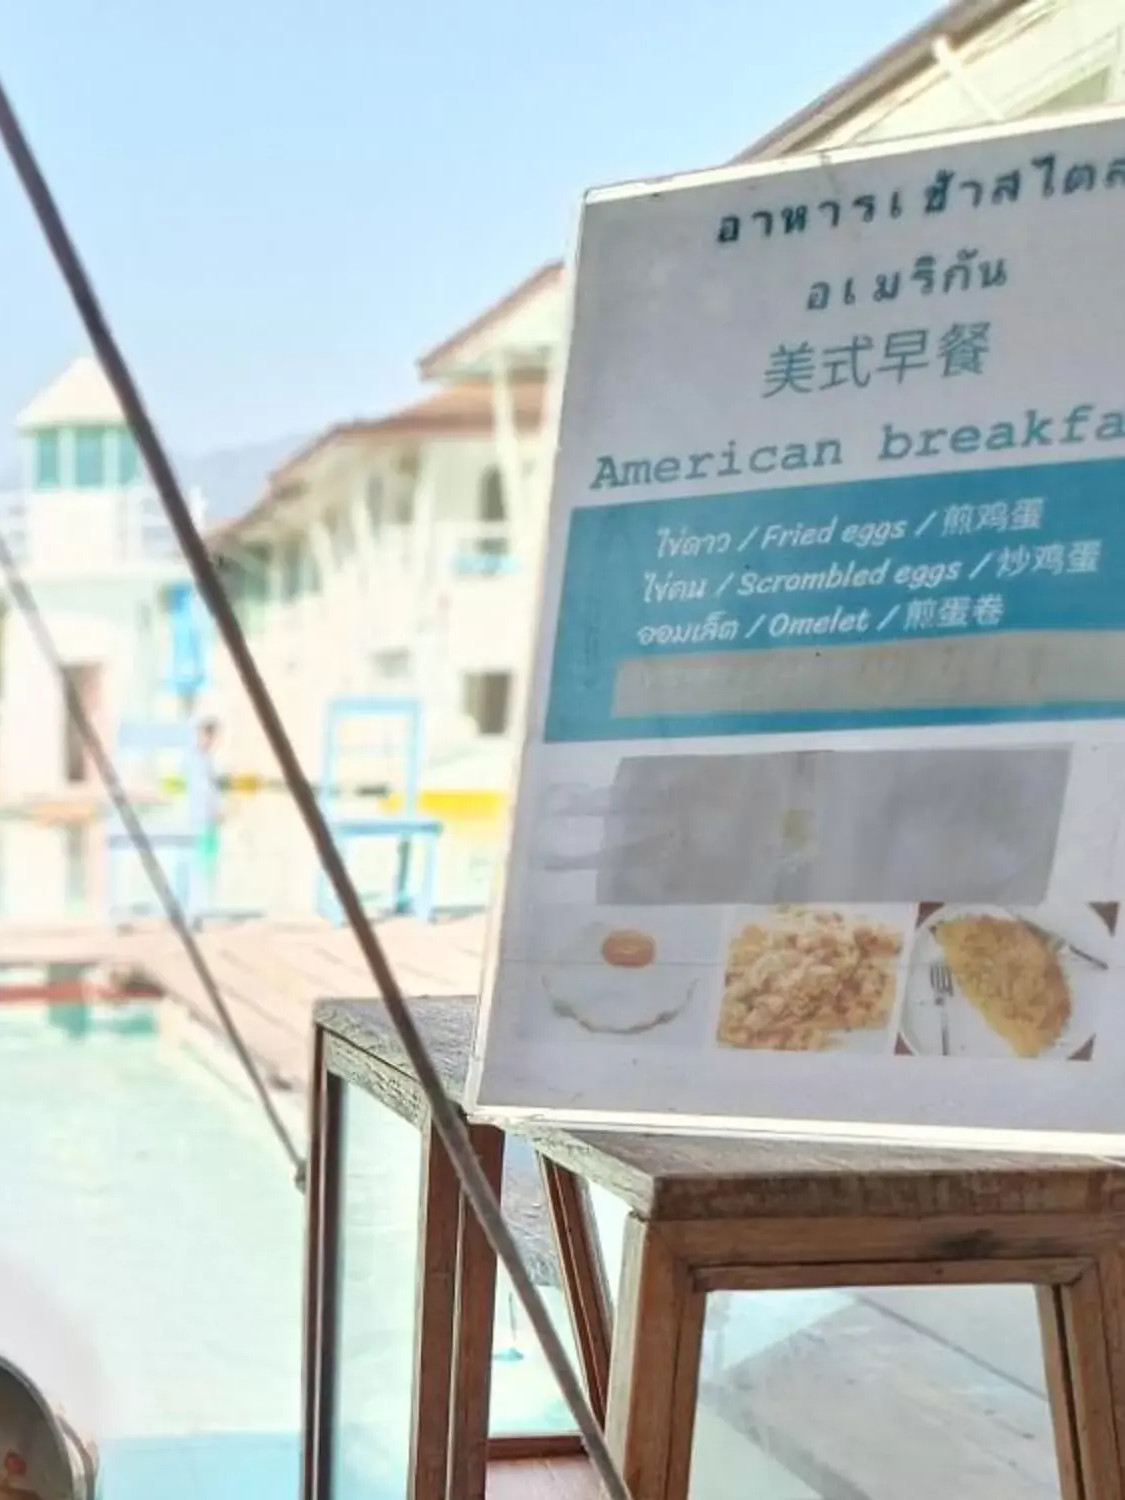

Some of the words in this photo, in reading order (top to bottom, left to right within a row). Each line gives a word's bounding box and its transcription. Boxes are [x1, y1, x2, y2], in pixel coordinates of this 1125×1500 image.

[806, 247, 1008, 311] อเมริกัน
[761, 321, 991, 399] 美式早餐
[589, 437, 843, 490] American
[877, 403, 1125, 462] breakfa
[656, 523, 732, 559] ไข่ดาว
[760, 513, 840, 550] Fried
[841, 519, 908, 548] eggs
[941, 497, 1045, 537] 煎鸡蛋
[643, 569, 709, 604] ไข่คน
[893, 560, 964, 591] eggs
[995, 538, 1103, 580] 炒鸡蛋
[767, 605, 873, 638] Omelet
